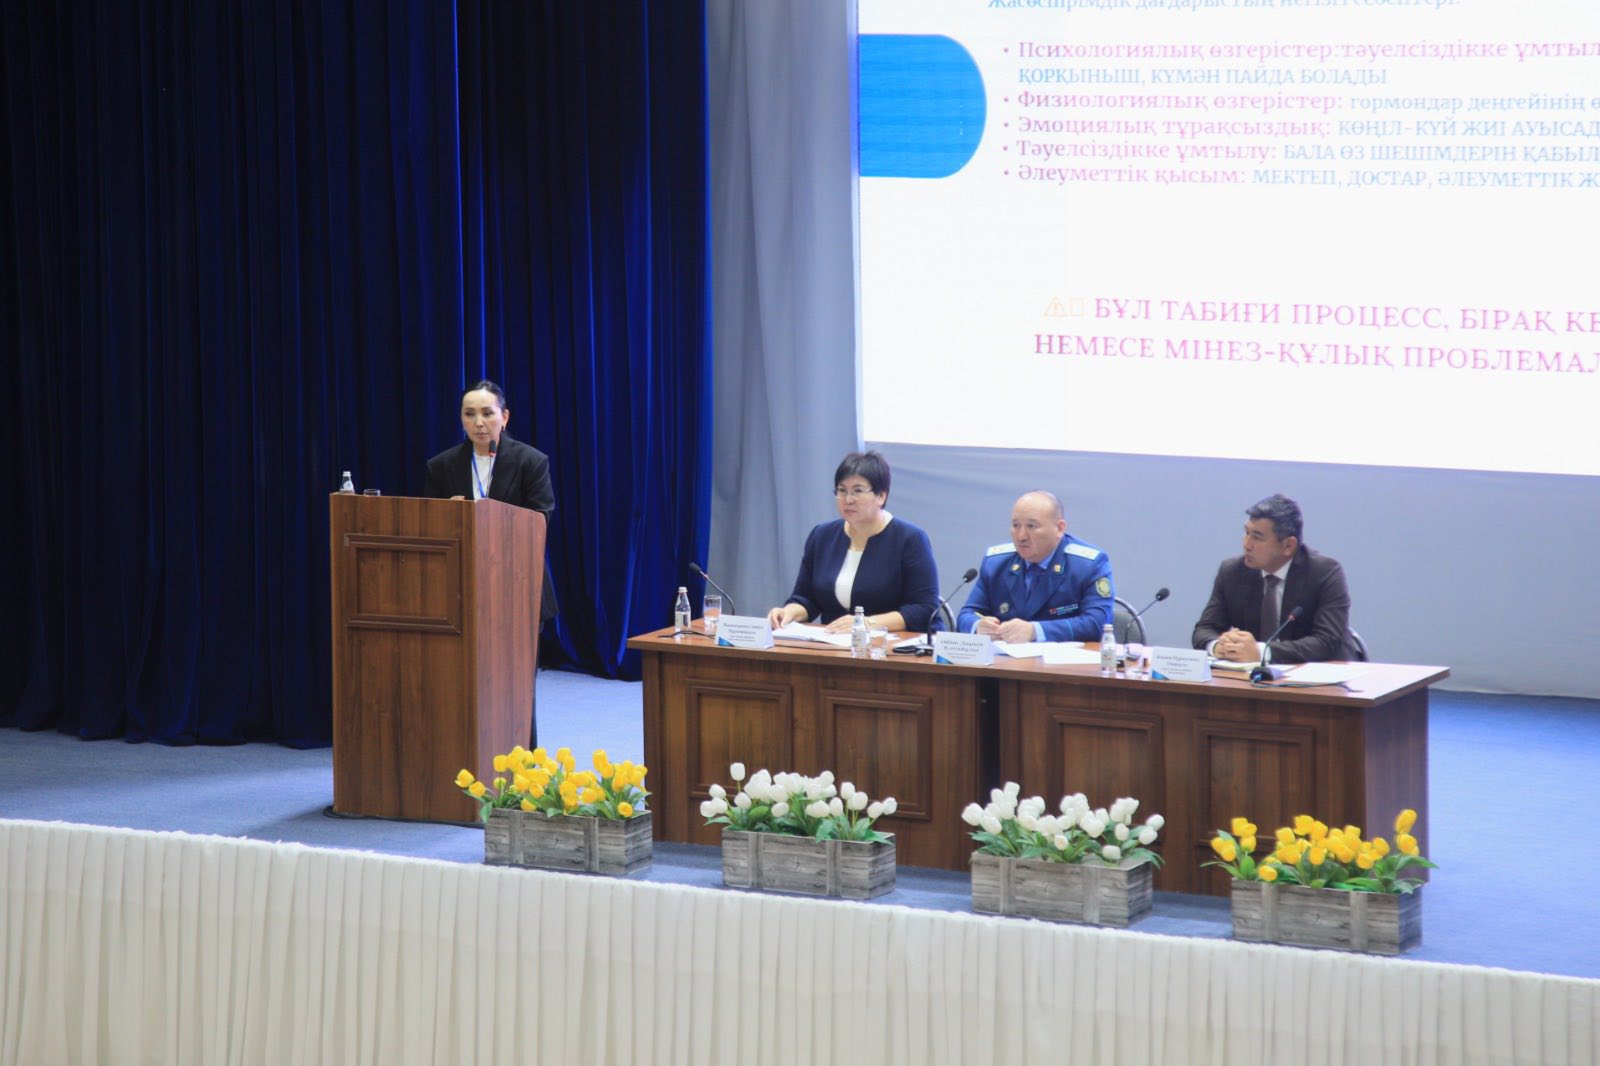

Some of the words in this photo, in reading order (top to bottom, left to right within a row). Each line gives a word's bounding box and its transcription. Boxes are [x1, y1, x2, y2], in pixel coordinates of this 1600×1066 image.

[1018, 42, 1204, 61] Психологиялық
[1018, 67, 1145, 86] ҚОРҚЫНЫШ,
[1152, 68, 1220, 84] КҮМӘН
[1227, 65, 1294, 86] ПАЙДА
[1301, 68, 1387, 86] БОЛАДЫ
[1018, 91, 1208, 111] Физиологиялық
[1213, 91, 1343, 114] өзгерістер:
[1351, 95, 1463, 112] гормондар
[1467, 93, 1585, 111] деңгейінің
[1018, 116, 1156, 135] Эмоциялық
[1163, 120, 1330, 139] тұрақсыздық:
[1463, 120, 1504, 136] ЖИІ
[1017, 139, 1170, 161] Тәуелсіздікке
[1176, 143, 1277, 163] ұмтылу:
[1284, 145, 1334, 160] БАЛА
[1340, 145, 1364, 161] ӨЗ
[1018, 164, 1148, 186] Әлеуметтік
[1154, 168, 1246, 186] қысым:
[1252, 169, 1341, 187] МЕКТЕП,
[1347, 170, 1432, 188] ДОСТАР,
[1095, 297, 1150, 320] БҰЛ
[1161, 299, 1280, 324] ТАБИҒИ
[1291, 303, 1448, 332] ПРОЦЕСС,
[1460, 308, 1556, 336] БІРАҚ
[1034, 333, 1154, 359] НЕМЕСЕ
[1164, 338, 1394, 371] МІНЕЗ-ҚҰЛЫҚ
